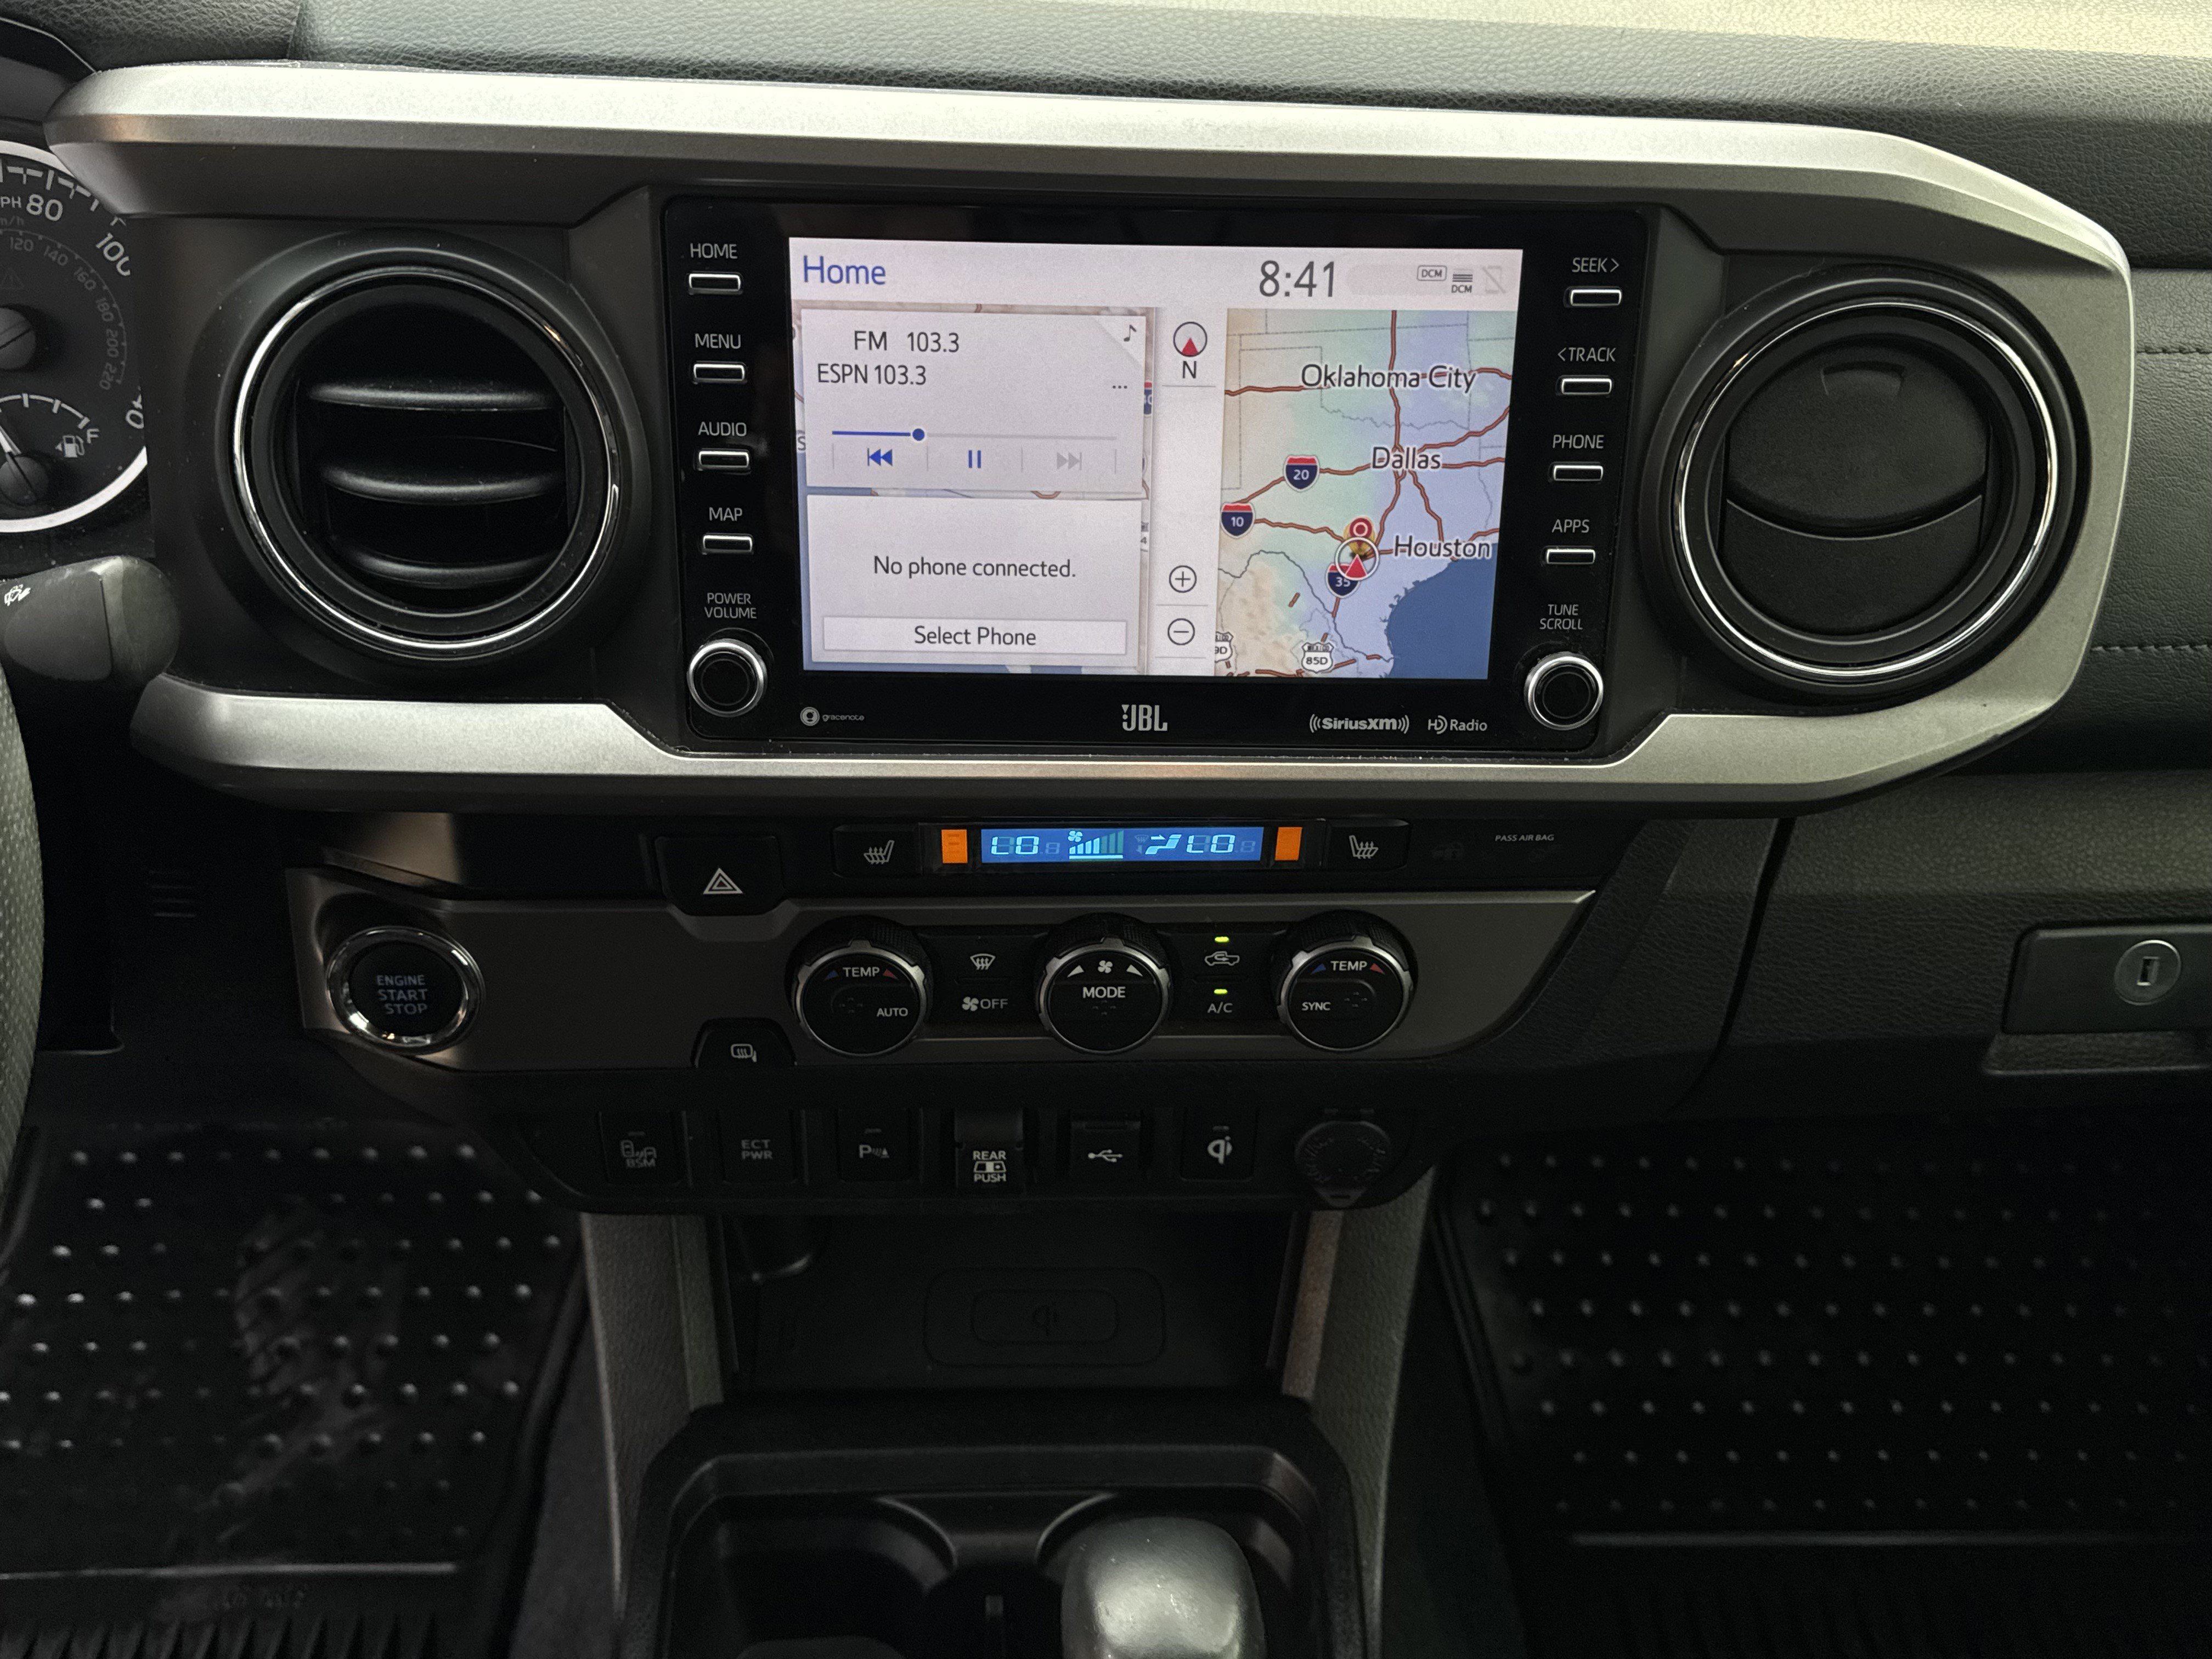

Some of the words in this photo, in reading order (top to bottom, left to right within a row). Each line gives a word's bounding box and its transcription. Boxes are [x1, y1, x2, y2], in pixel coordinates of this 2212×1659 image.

[26, 194, 63, 222] 80
[10, 236, 34, 252] 120
[43, 245, 69, 266] 140
[690, 243, 738, 259] HOME
[803, 255, 886, 285] Home
[1421, 269, 1442, 278] DCM
[73, 267, 97, 291] 160
[1259, 260, 1335, 298] 8:41
[1451, 285, 1472, 294] DCM
[95, 297, 114, 322] 180
[695, 334, 741, 349] MENU
[854, 331, 887, 351] FM
[907, 332, 960, 353] 103.3
[818, 363, 868, 384] ESPN
[874, 365, 927, 385] 103.3
[1182, 361, 1197, 379] N
[1301, 364, 1420, 388] Oklahoma
[1429, 365, 1477, 393] City
[698, 421, 747, 436] AUDIO
[87, 428, 100, 444] F
[1552, 435, 1604, 449] PHONE
[1372, 446, 1441, 469] Dallas
[1293, 469, 1310, 481] 20
[709, 507, 743, 521] MAP
[1231, 516, 1244, 527] 10
[1551, 519, 1590, 533] APPS
[1394, 535, 1491, 558] Houston
[874, 556, 902, 575] No
[909, 556, 967, 579] phone
[973, 559, 1076, 578] connected.
[1335, 577, 1351, 588] 35
[707, 592, 752, 605] POWER
[704, 607, 757, 619] VOLUME
[1548, 604, 1579, 616] TUNE
[1539, 618, 1583, 630] SCROLL
[914, 625, 971, 645] Select
[977, 627, 1036, 646] Phone
[1306, 657, 1328, 665] 85D
[1122, 704, 1169, 731] JBL
[1449, 719, 1488, 731] Radio
[1494, 834, 1517, 842] PASS
[1534, 833, 1555, 842] BAG
[842, 967, 880, 978] TEMP
[1330, 961, 1368, 971] TEMP
[377, 974, 426, 986] ENGINE
[377, 989, 428, 1001] START
[1082, 986, 1126, 999] MODE
[385, 1002, 428, 1015] STOP
[980, 998, 1008, 1010] OFF
[1207, 1002, 1233, 1014] A/C
[1301, 1002, 1331, 1011] SYNC
[876, 1007, 909, 1017] AUTO
[741, 1139, 771, 1149] ECT
[741, 1150, 773, 1160] PWR
[972, 1150, 1007, 1160] REAR
[625, 1158, 656, 1169] BSM
[973, 1173, 1007, 1183] PUSH
